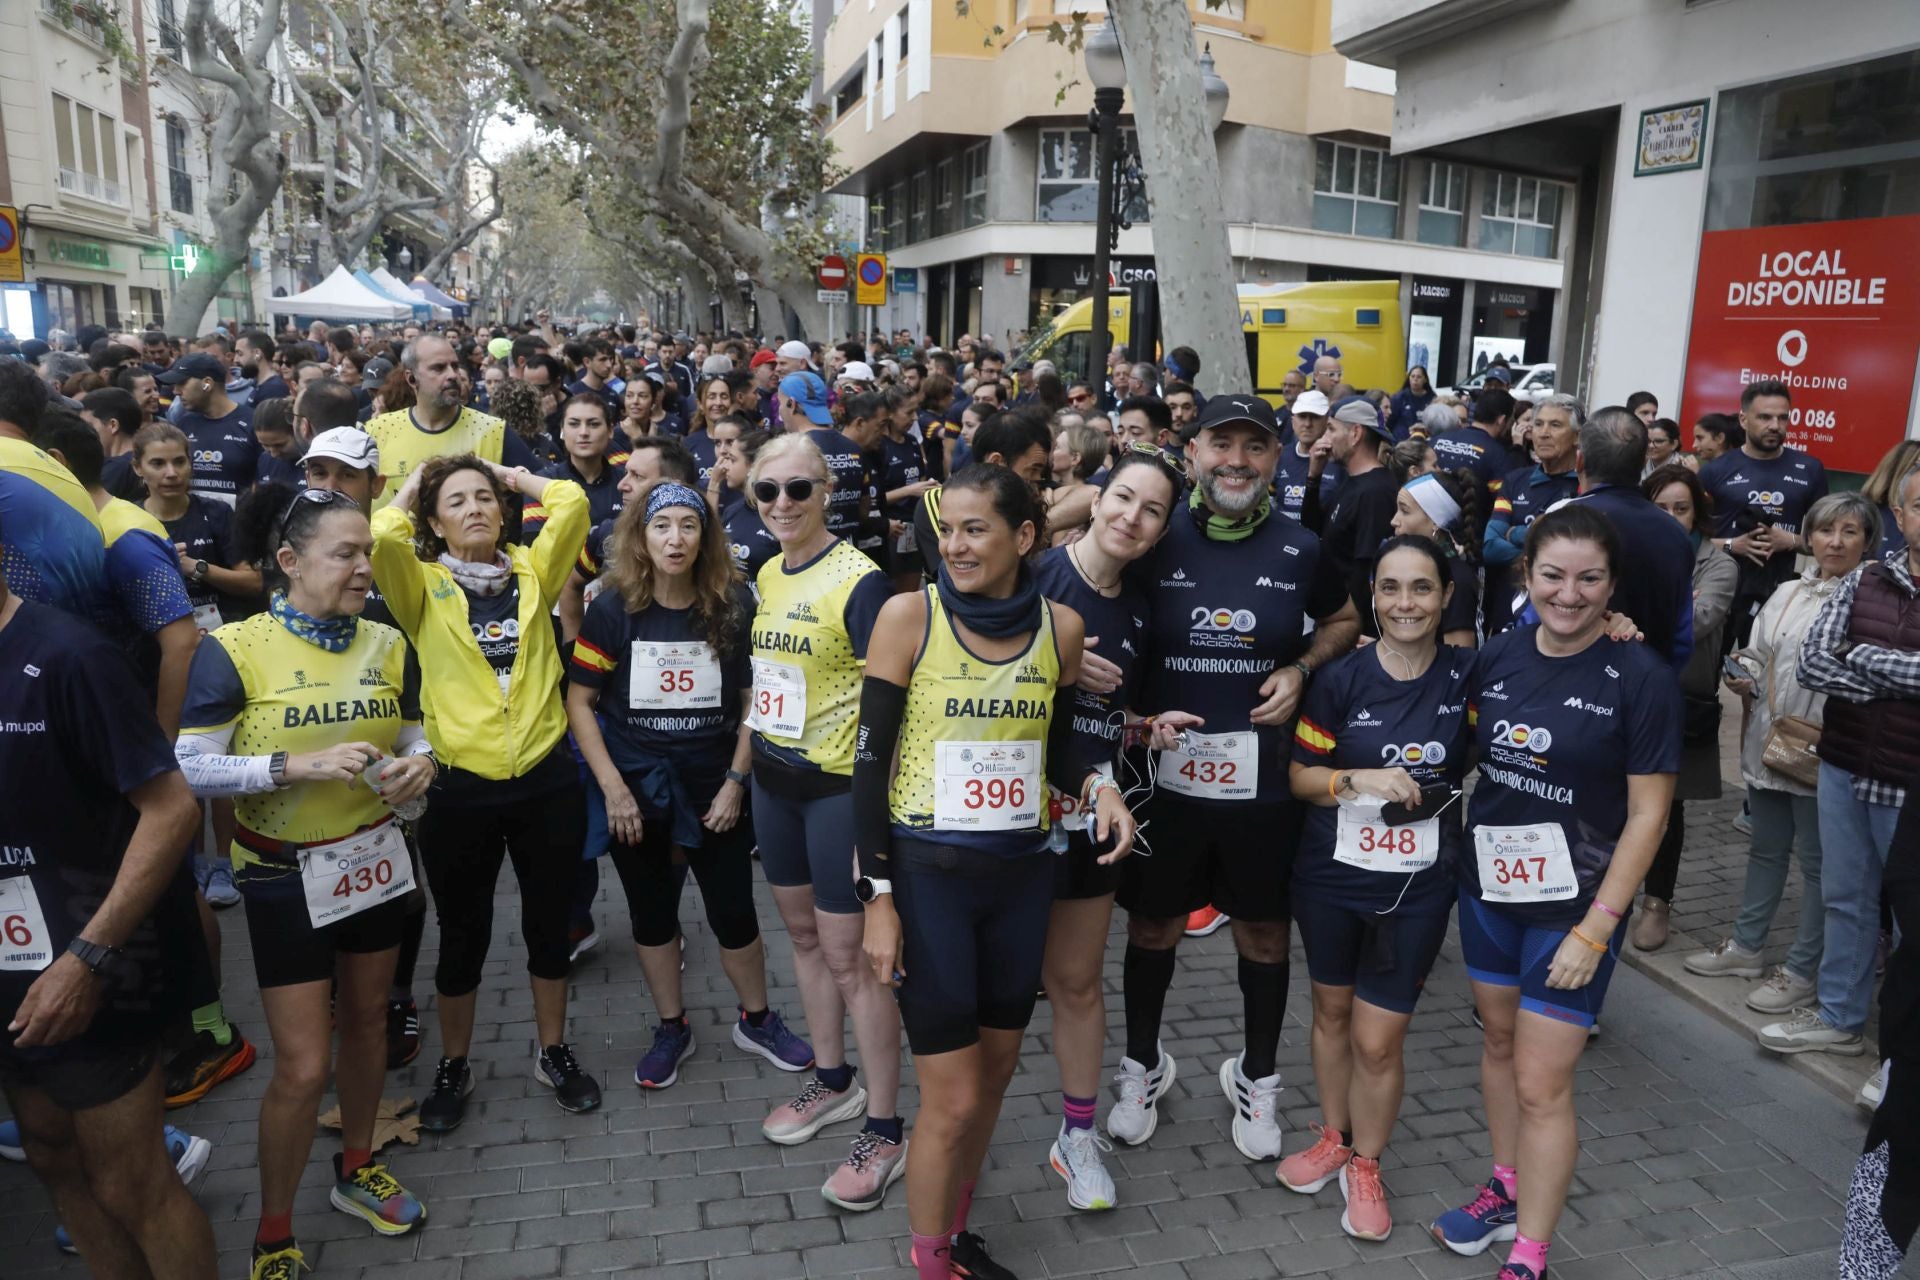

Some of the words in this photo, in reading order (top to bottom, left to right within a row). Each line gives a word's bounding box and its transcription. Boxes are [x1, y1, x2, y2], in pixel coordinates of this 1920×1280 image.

[1760, 250, 1846, 278] LOCAL
[1420, 285, 1450, 298] MACSON
[1728, 278, 1886, 306] DISPONIBLE
[1788, 408, 1800, 426] 0
[1805, 408, 1836, 429] 086
[1434, 444, 1480, 459] NACIONAL
[1437, 439, 1474, 450] POLICIA
[194, 450, 223, 463] 200
[698, 468, 713, 479] 20
[1748, 490, 1784, 506] 200
[1160, 579, 1197, 588] Santander
[1274, 580, 1296, 592] mupol
[1190, 606, 1256, 632] 200
[1190, 632, 1240, 642] POLICIA
[1190, 640, 1253, 649] NACIONAL
[480, 642, 517, 651] OLICIA
[1164, 656, 1275, 674] #YOCORROCONLUCA
[660, 670, 694, 692] 35
[1584, 704, 1614, 716] mupol
[6, 720, 46, 734] mupol
[1491, 720, 1552, 754] 200
[1382, 741, 1446, 768] 200
[1490, 746, 1535, 762] POLICIA
[986, 764, 996, 772] HLA
[1180, 760, 1236, 784] 432
[1491, 754, 1546, 774] NACIONAL
[964, 778, 1025, 810] 396
[1358, 826, 1416, 854] 348
[332, 859, 393, 898] 430
[1494, 857, 1546, 884] 347
[1540, 886, 1572, 894] #RUTA091
[0, 914, 32, 946] 6
[4, 952, 46, 962] #RUTA091
